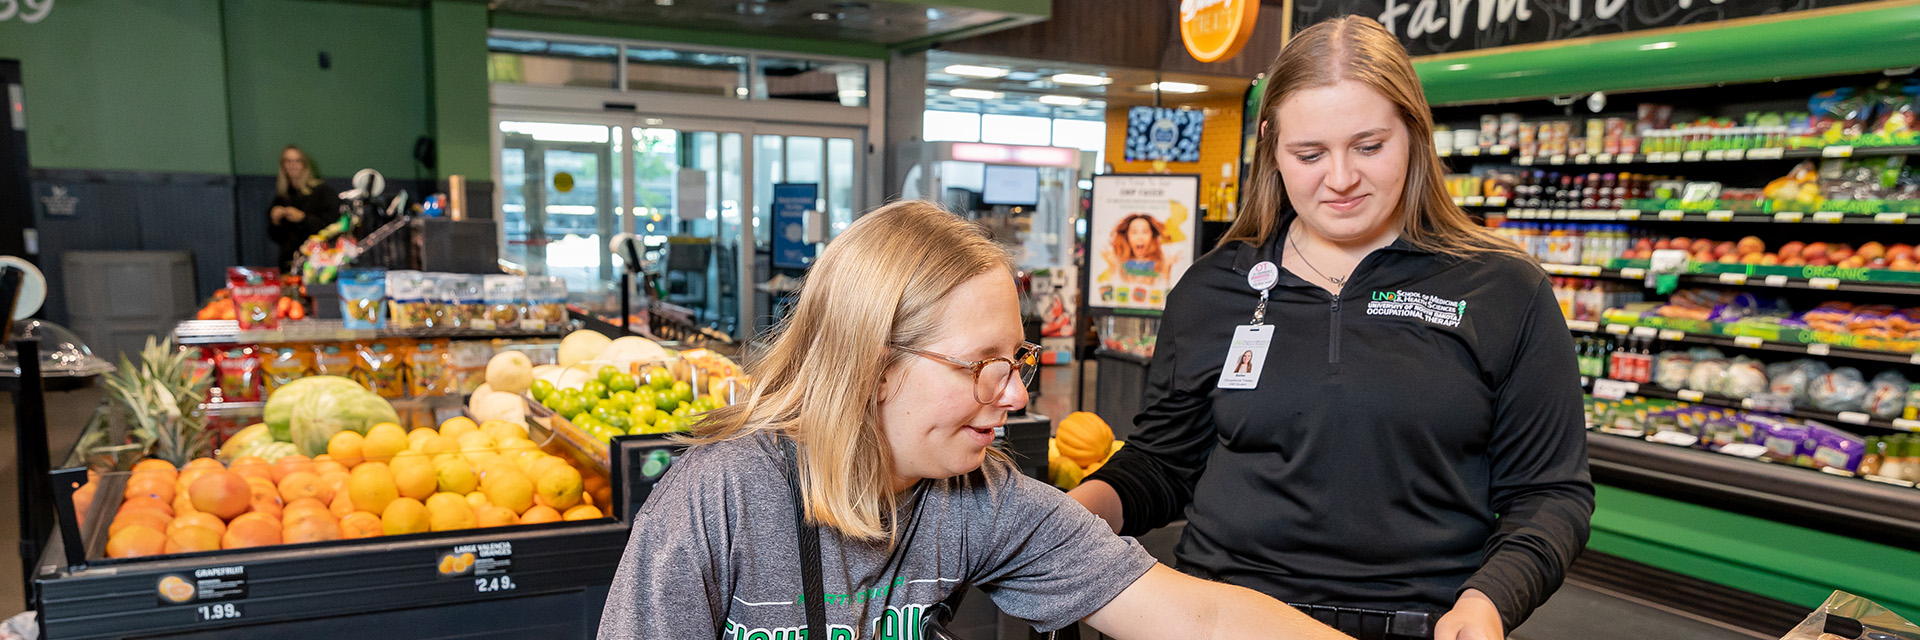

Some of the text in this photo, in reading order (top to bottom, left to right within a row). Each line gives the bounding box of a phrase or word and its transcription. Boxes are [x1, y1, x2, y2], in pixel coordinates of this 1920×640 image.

[1255, 262, 1268, 272] OT
[1802, 264, 1871, 281] ORGANIC
[1367, 308, 1460, 327] OCCUPATIONAL THERAPY
[477, 542, 511, 552] VALENCIA
[195, 566, 244, 578] GRAPEFRUIT
